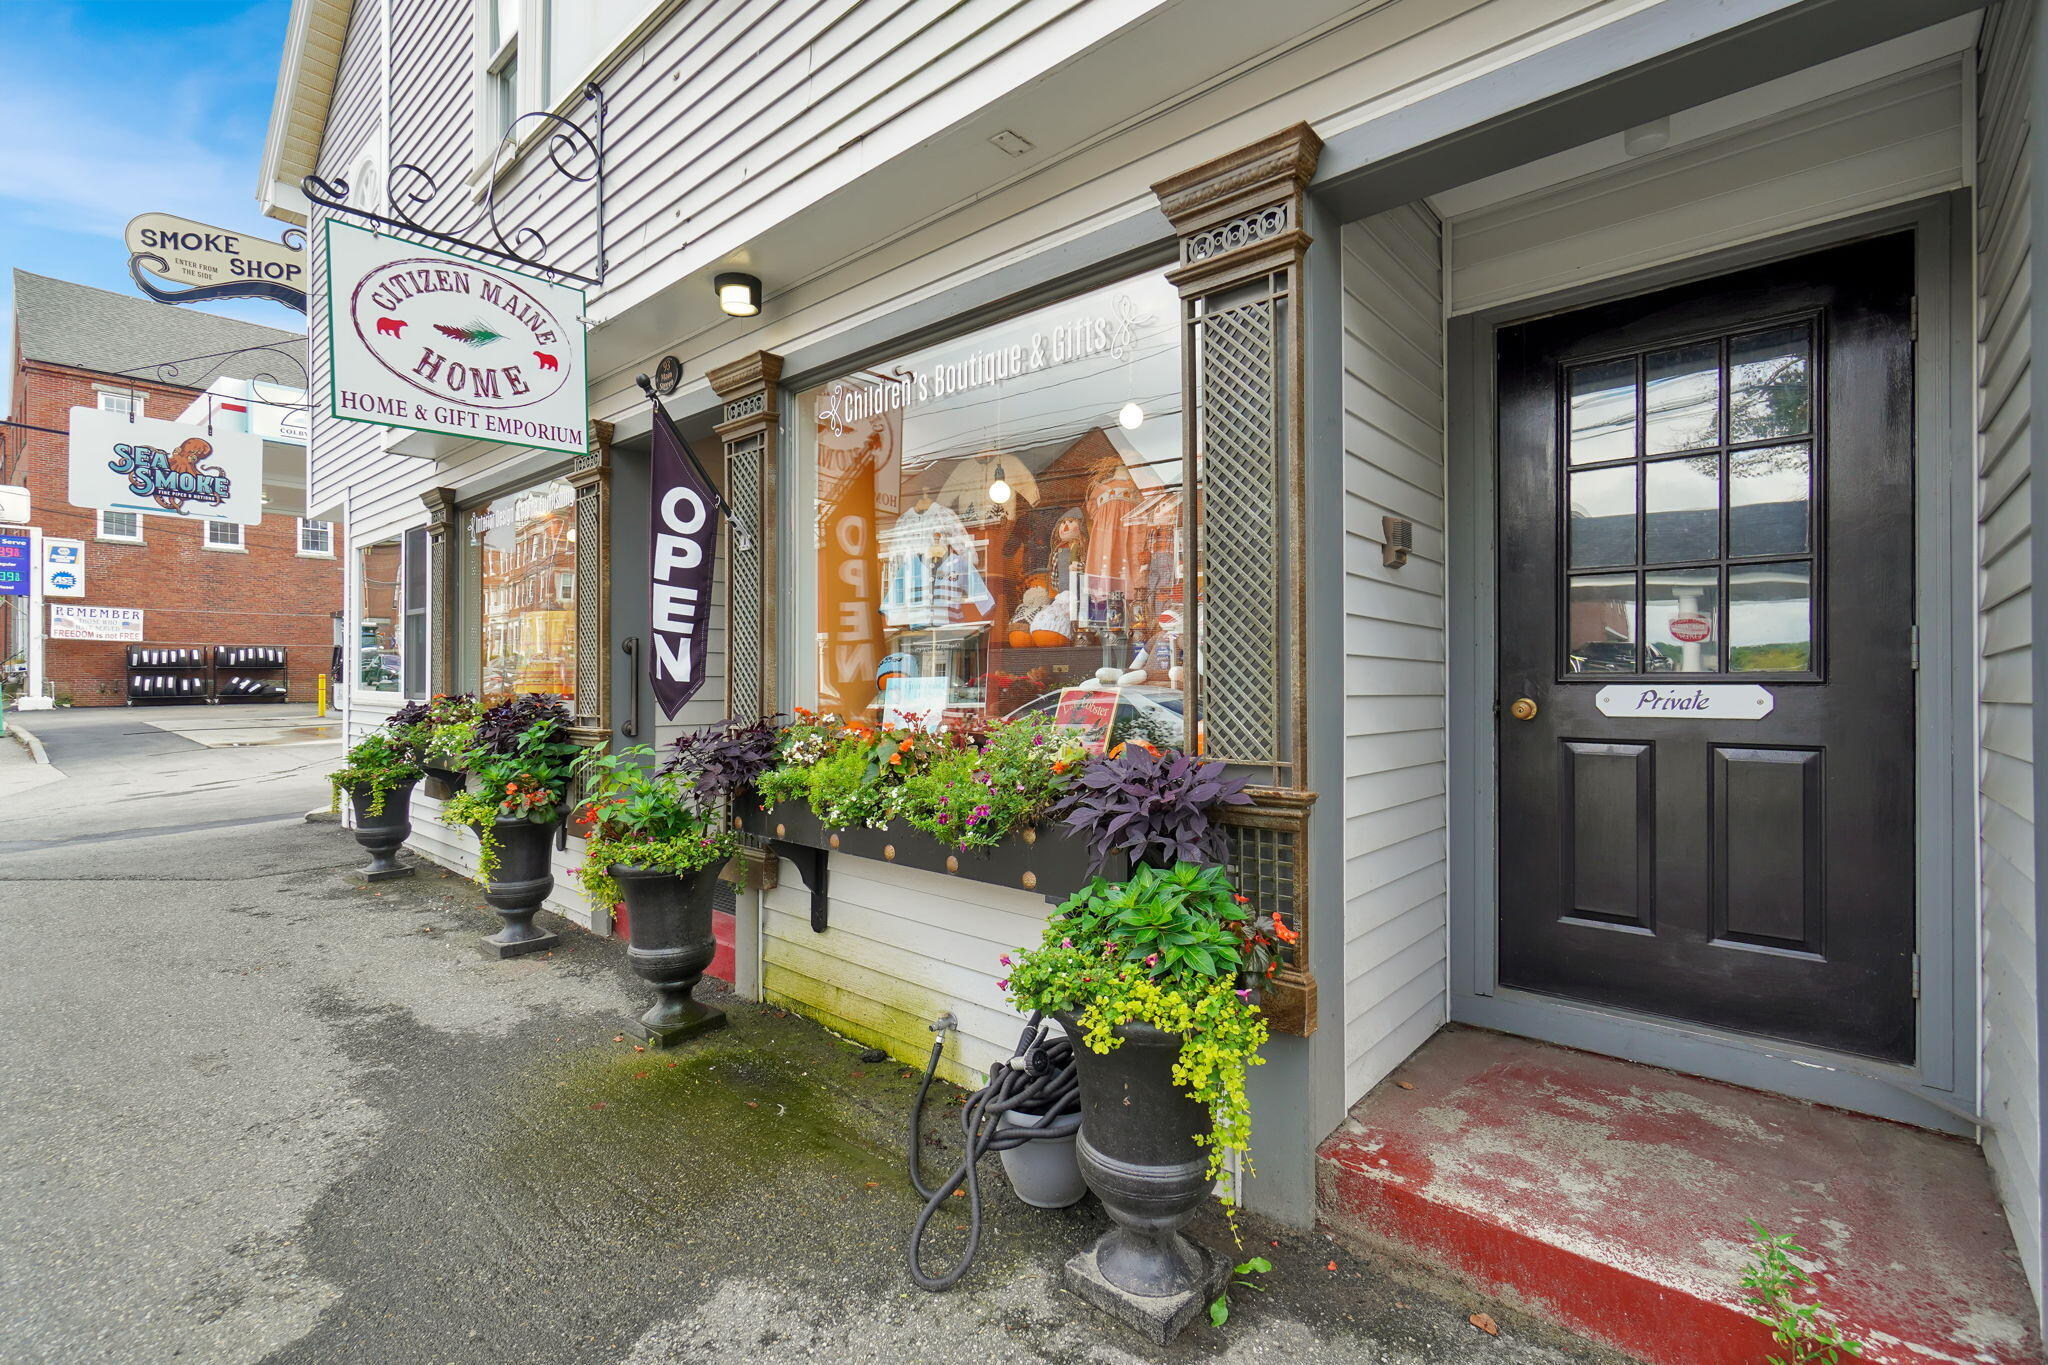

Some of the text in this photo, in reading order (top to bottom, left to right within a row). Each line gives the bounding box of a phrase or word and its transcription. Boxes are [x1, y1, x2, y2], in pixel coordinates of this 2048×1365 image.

[140, 228, 240, 255] SMOKE
[175, 257, 218, 273] ENTER FROM
[182, 267, 213, 280] THE SIDE
[230, 258, 302, 281] SHOP
[371, 269, 557, 346] CITIZEN MAINE
[412, 347, 530, 400] HOME
[844, 315, 1107, 424] Children's Boutique & Gifts
[340, 390, 583, 445] HOME & GIFT EMPORIUM
[108, 443, 170, 474] SEA
[128, 467, 231, 499] SMOKE
[1, 538, 27, 546] Serve
[653, 486, 706, 682] OPEN
[55, 606, 140, 620] REMEMBER
[53, 629, 94, 638] FREEDOM
[119, 632, 140, 640] FREE
[1634, 688, 1710, 711] Private
